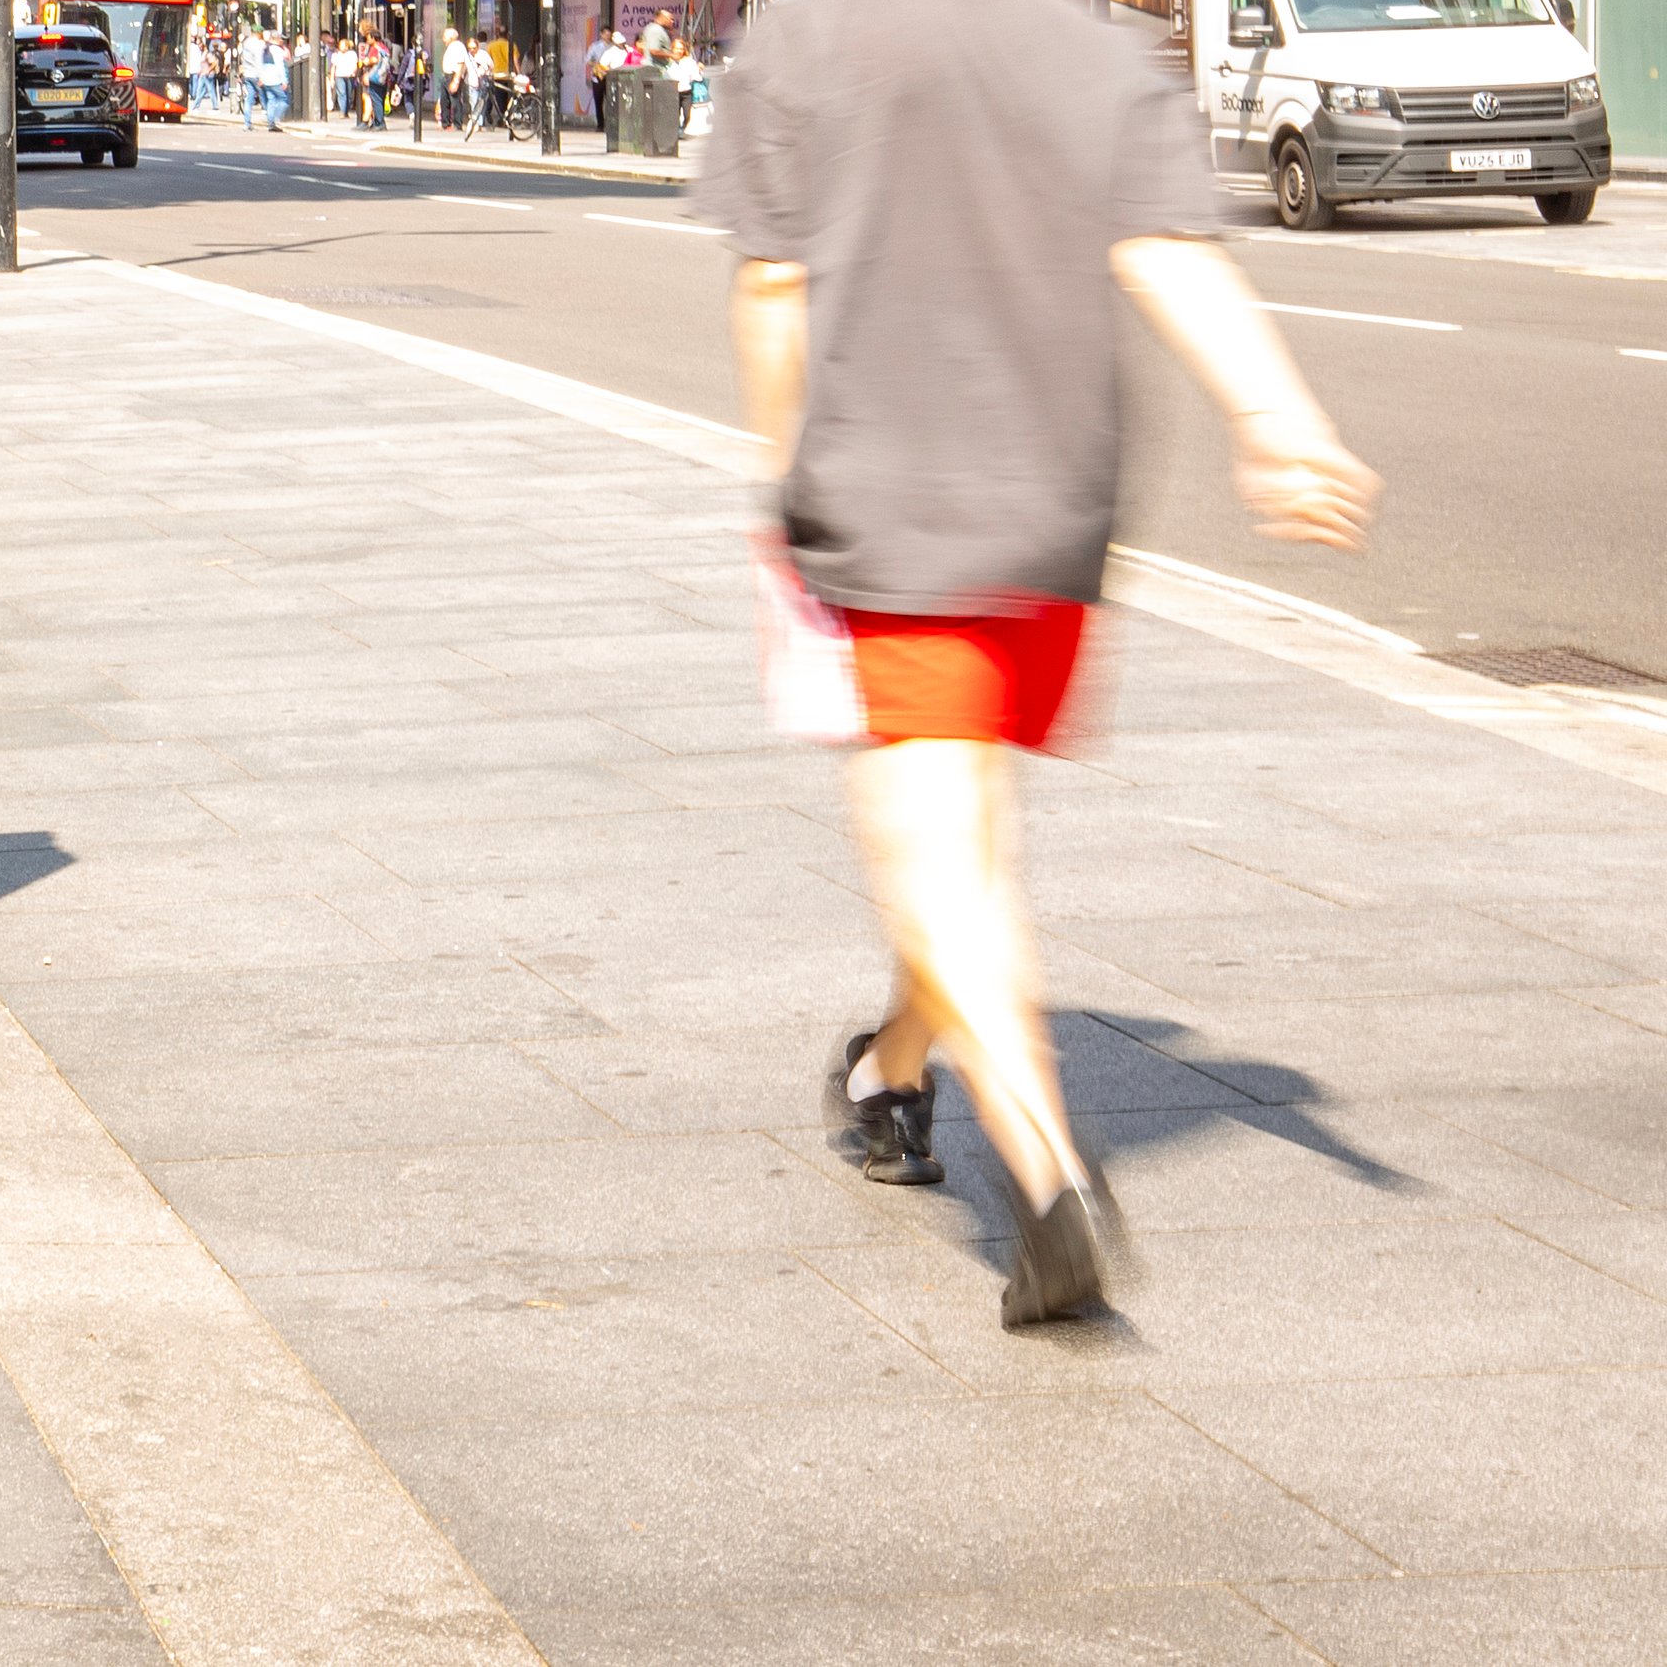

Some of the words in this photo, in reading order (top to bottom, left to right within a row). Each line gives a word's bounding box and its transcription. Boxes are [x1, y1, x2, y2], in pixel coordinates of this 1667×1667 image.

[622, 4, 630, 15] A
[632, 6, 654, 15] new
[622, 18, 634, 28] of
[1221, 92, 1264, 118] BoConcept
